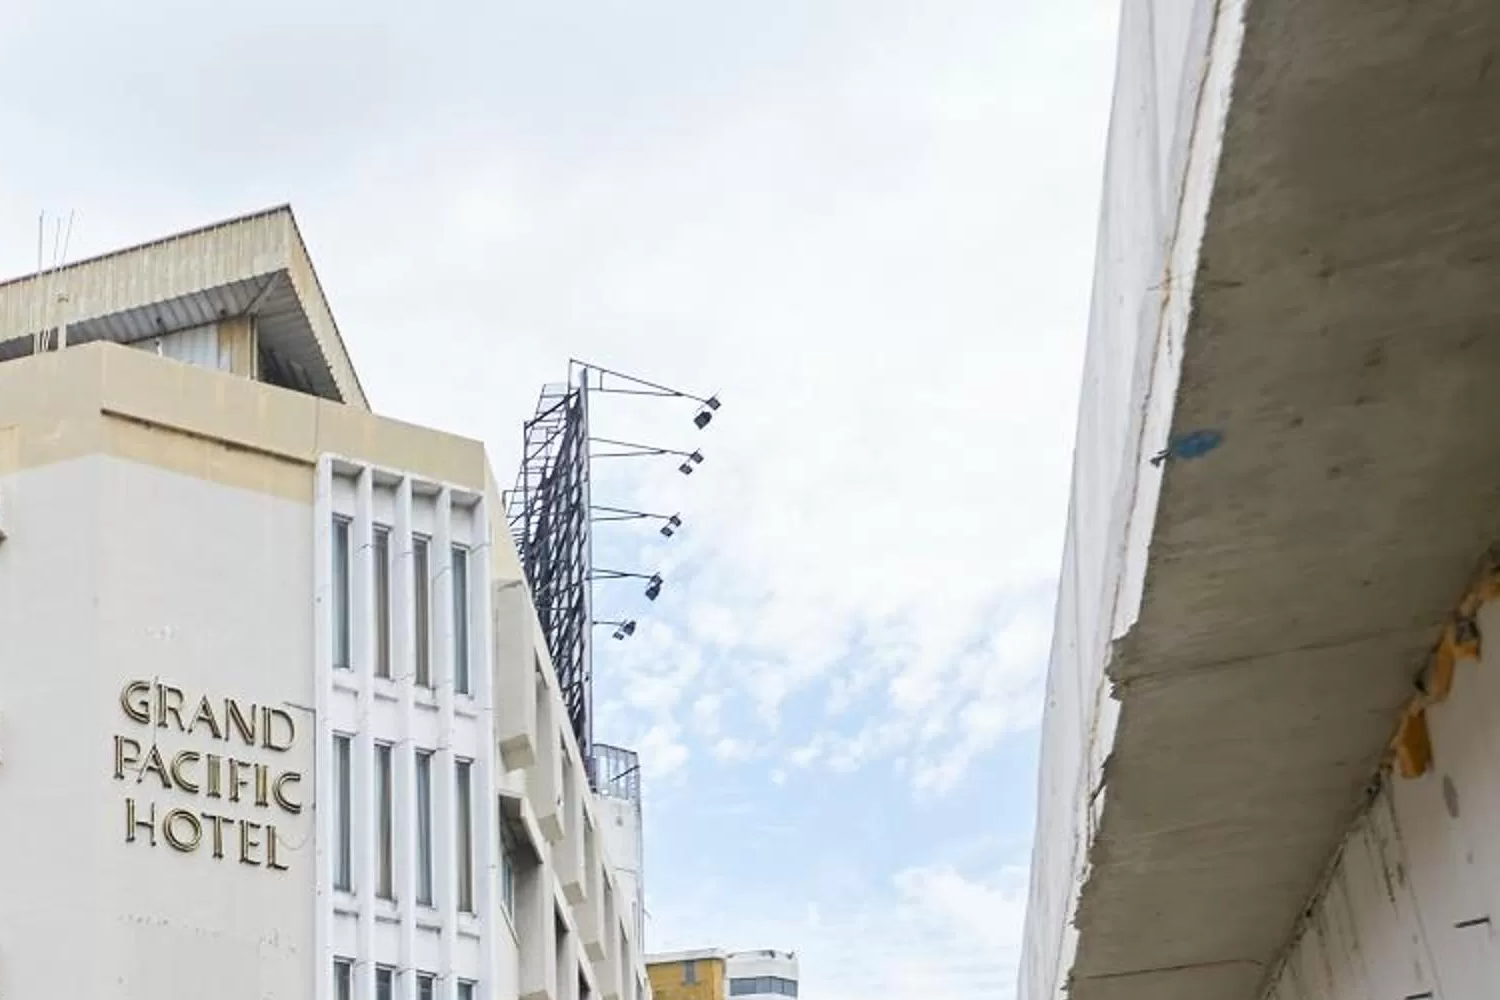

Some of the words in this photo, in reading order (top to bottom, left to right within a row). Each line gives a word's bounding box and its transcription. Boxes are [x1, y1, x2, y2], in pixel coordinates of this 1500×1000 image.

[120, 680, 296, 753] GRAND
[113, 734, 301, 815] PACIFIC
[124, 797, 289, 871] HOTEL
